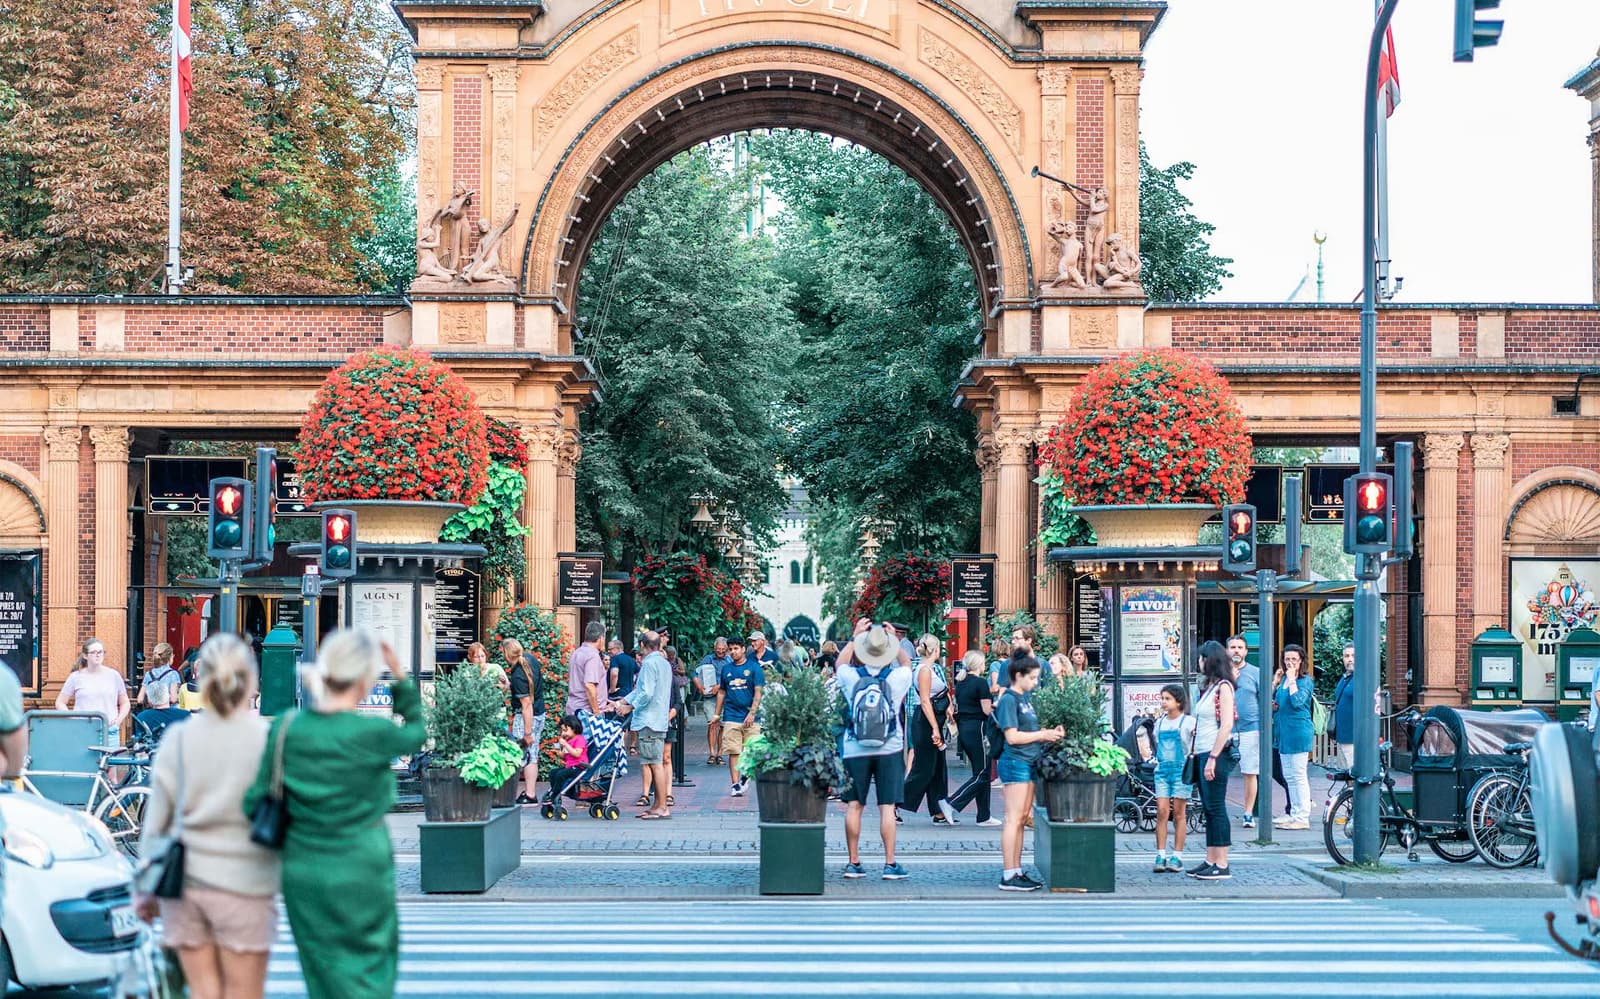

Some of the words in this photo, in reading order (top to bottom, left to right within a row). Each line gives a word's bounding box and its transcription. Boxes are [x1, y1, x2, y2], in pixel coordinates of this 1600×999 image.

[362, 592, 402, 601] AUGUST
[1127, 600, 1177, 611] TIVOLI
[1530, 623, 1560, 639] 175
[364, 694, 394, 705] IVO
[1129, 693, 1162, 701] KÆRLIG
